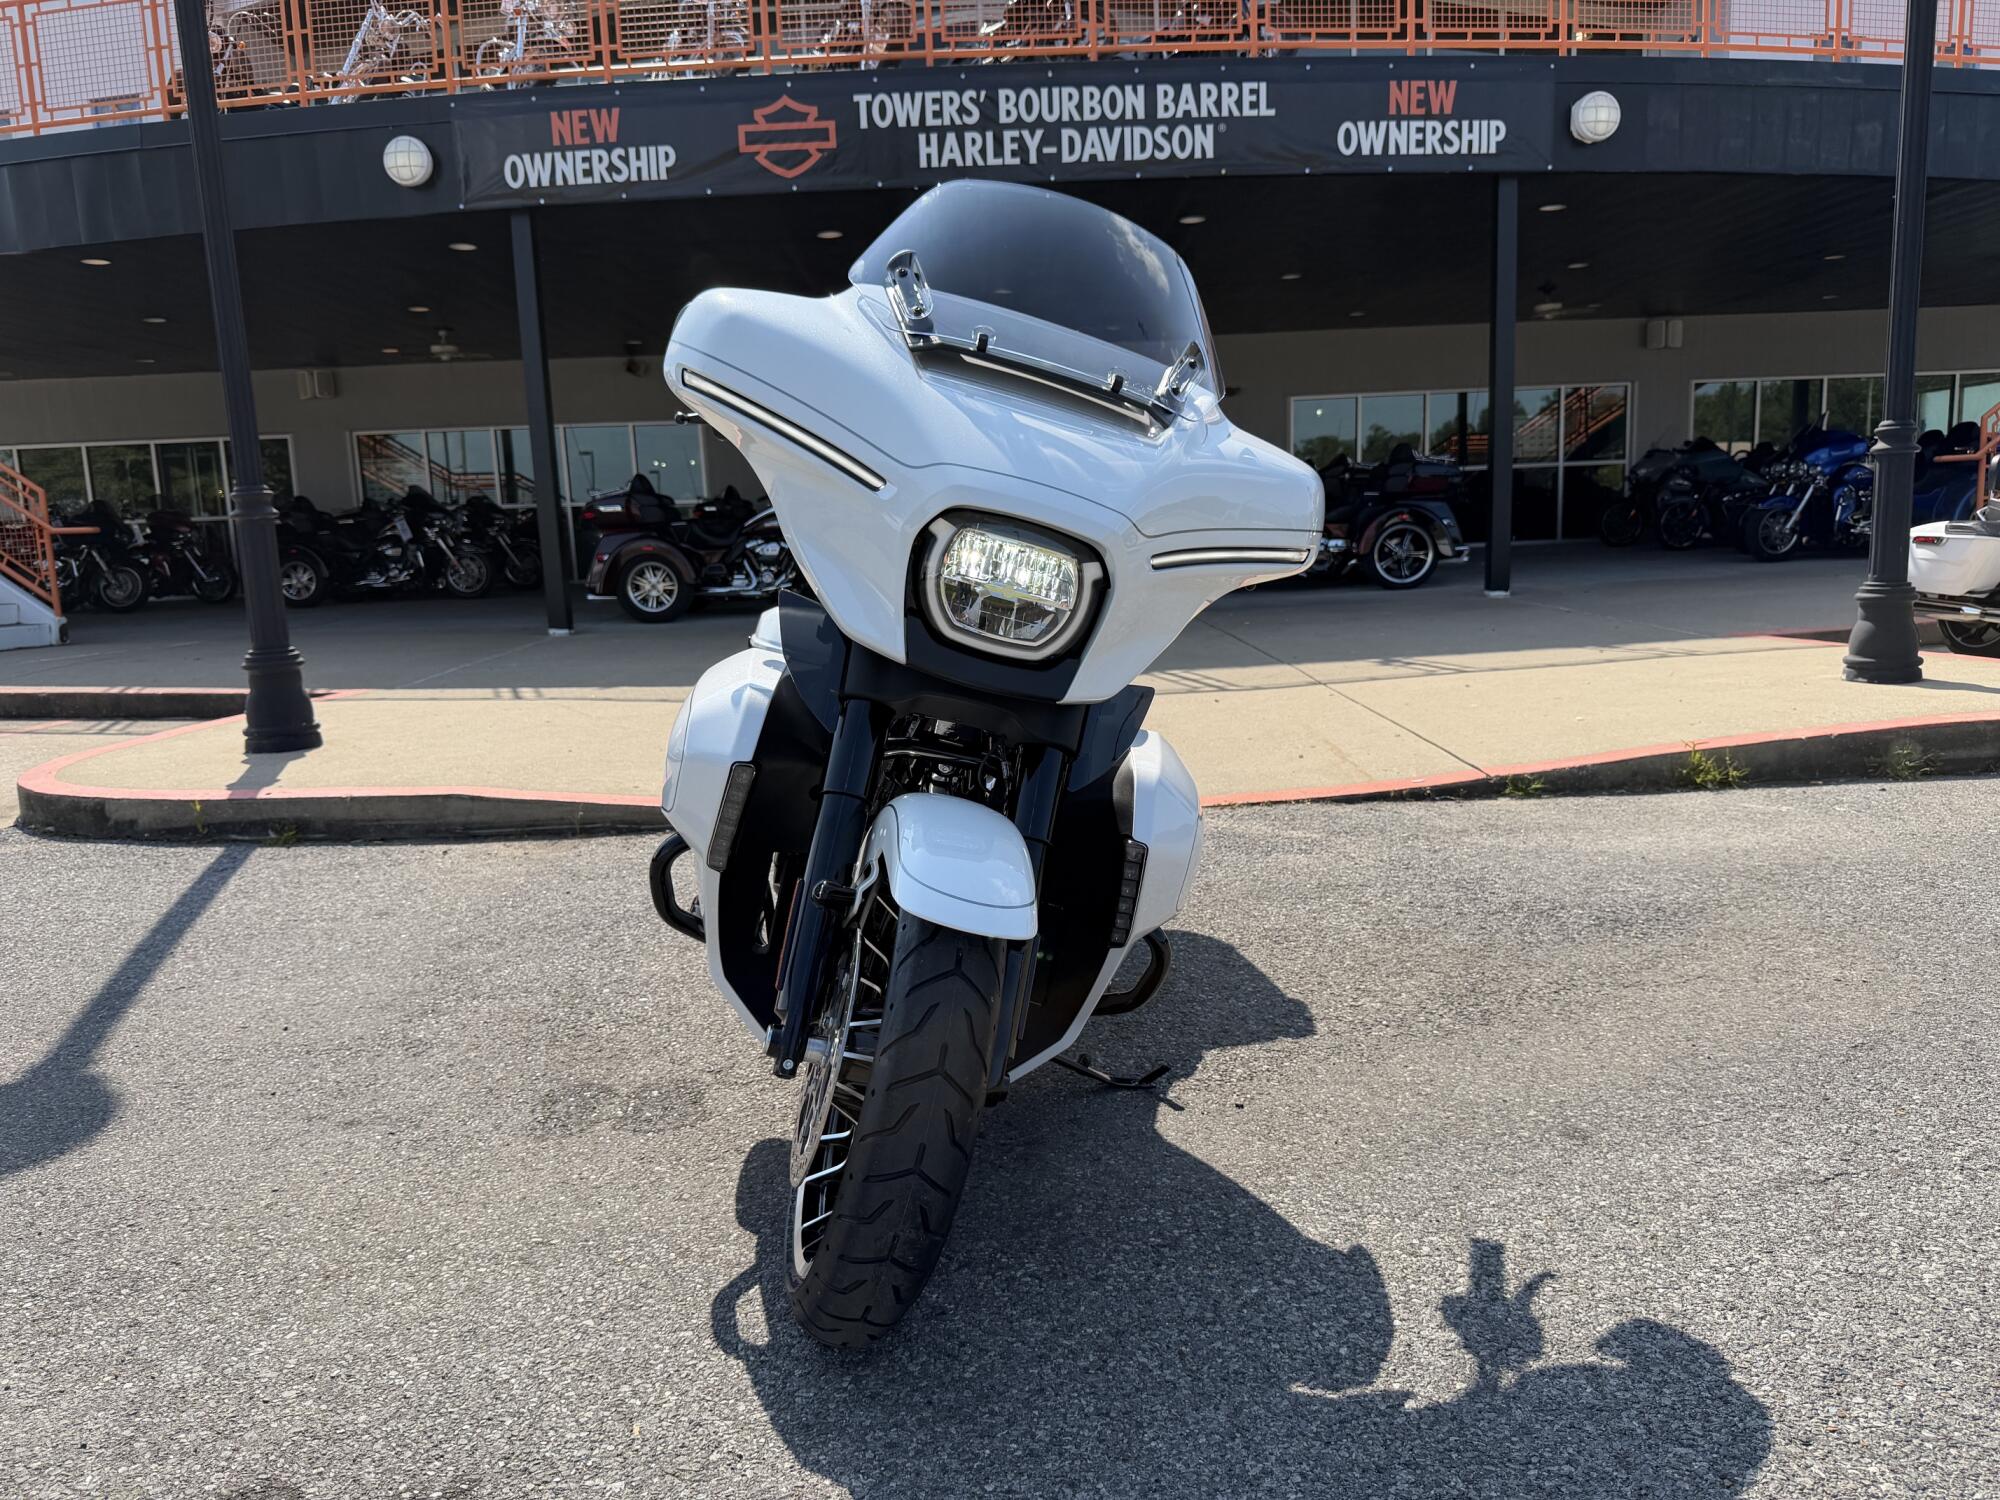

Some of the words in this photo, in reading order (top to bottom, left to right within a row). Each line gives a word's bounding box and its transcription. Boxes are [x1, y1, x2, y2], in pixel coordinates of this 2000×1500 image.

[853, 89, 986, 129] TOWERS'
[998, 84, 1145, 124] BOURBON
[1157, 81, 1276, 120] BARREL
[1388, 80, 1457, 115] NEW
[550, 107, 620, 146] NEW
[1337, 119, 1506, 156] OWNERSHIP
[503, 145, 676, 189] OWNERSHIP
